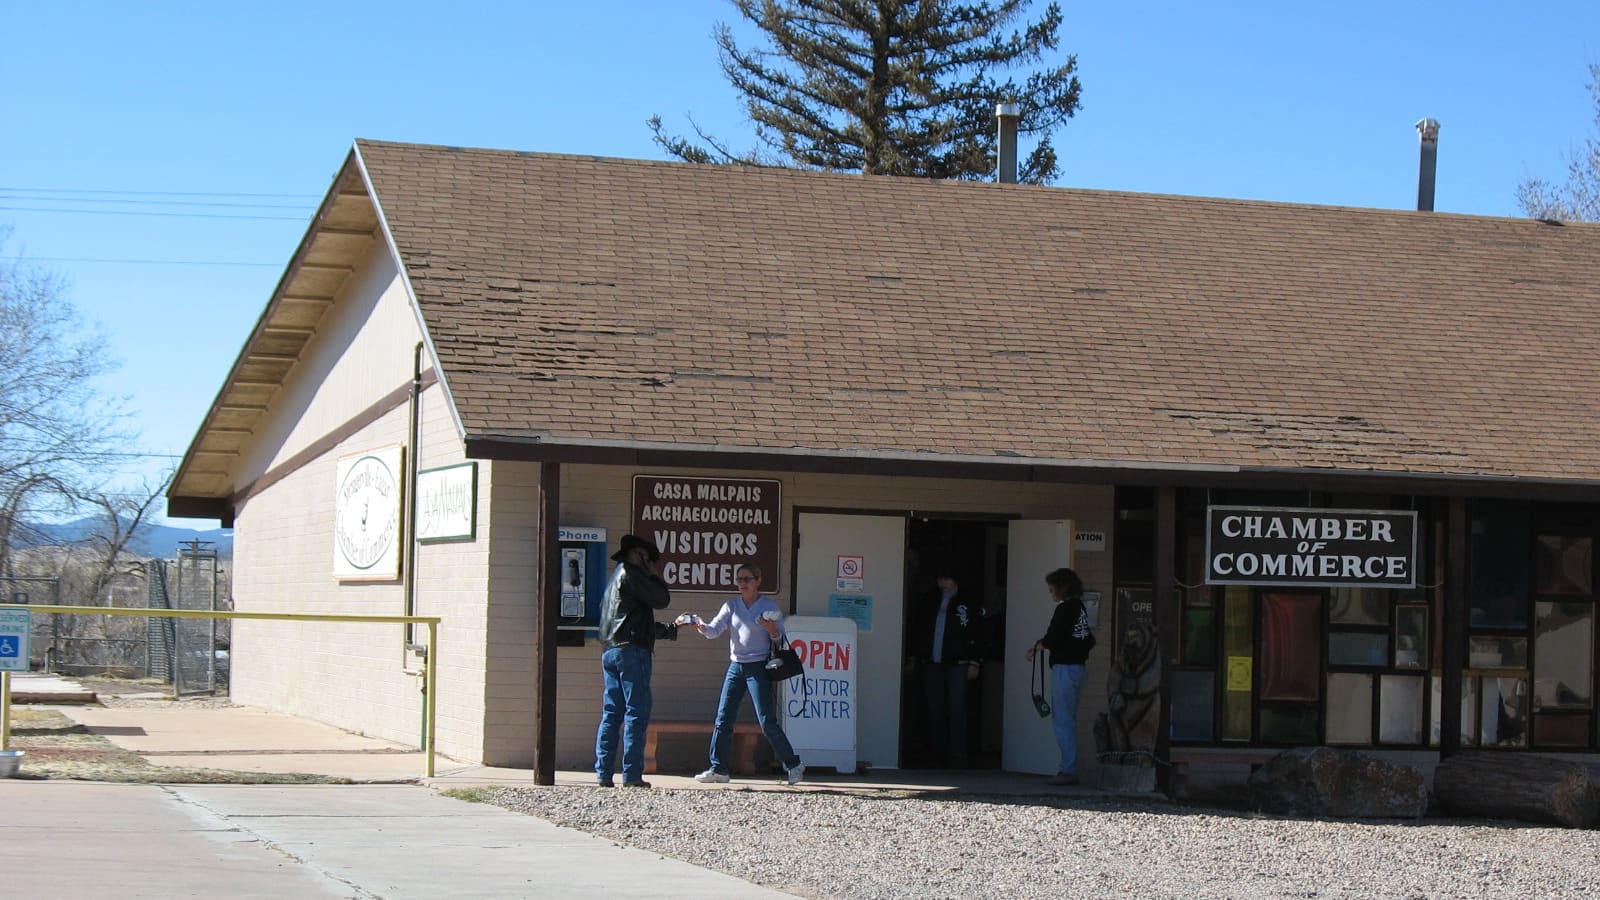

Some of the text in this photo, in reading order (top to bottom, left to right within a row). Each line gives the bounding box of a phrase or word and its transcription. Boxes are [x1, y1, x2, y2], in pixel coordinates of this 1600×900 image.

[653, 482, 761, 502] CASA MALPAIS
[641, 505, 771, 525] ARCHAEOLOGICAL
[558, 530, 598, 540] Phone
[1221, 515, 1395, 543] CHAMBER
[654, 530, 758, 556] VISITORS
[1296, 541, 1327, 553] OF
[1213, 552, 1407, 578] COMMERCE
[790, 639, 850, 671] OPEN
[789, 678, 849, 697] VISITOR
[788, 699, 850, 720] CENTER
